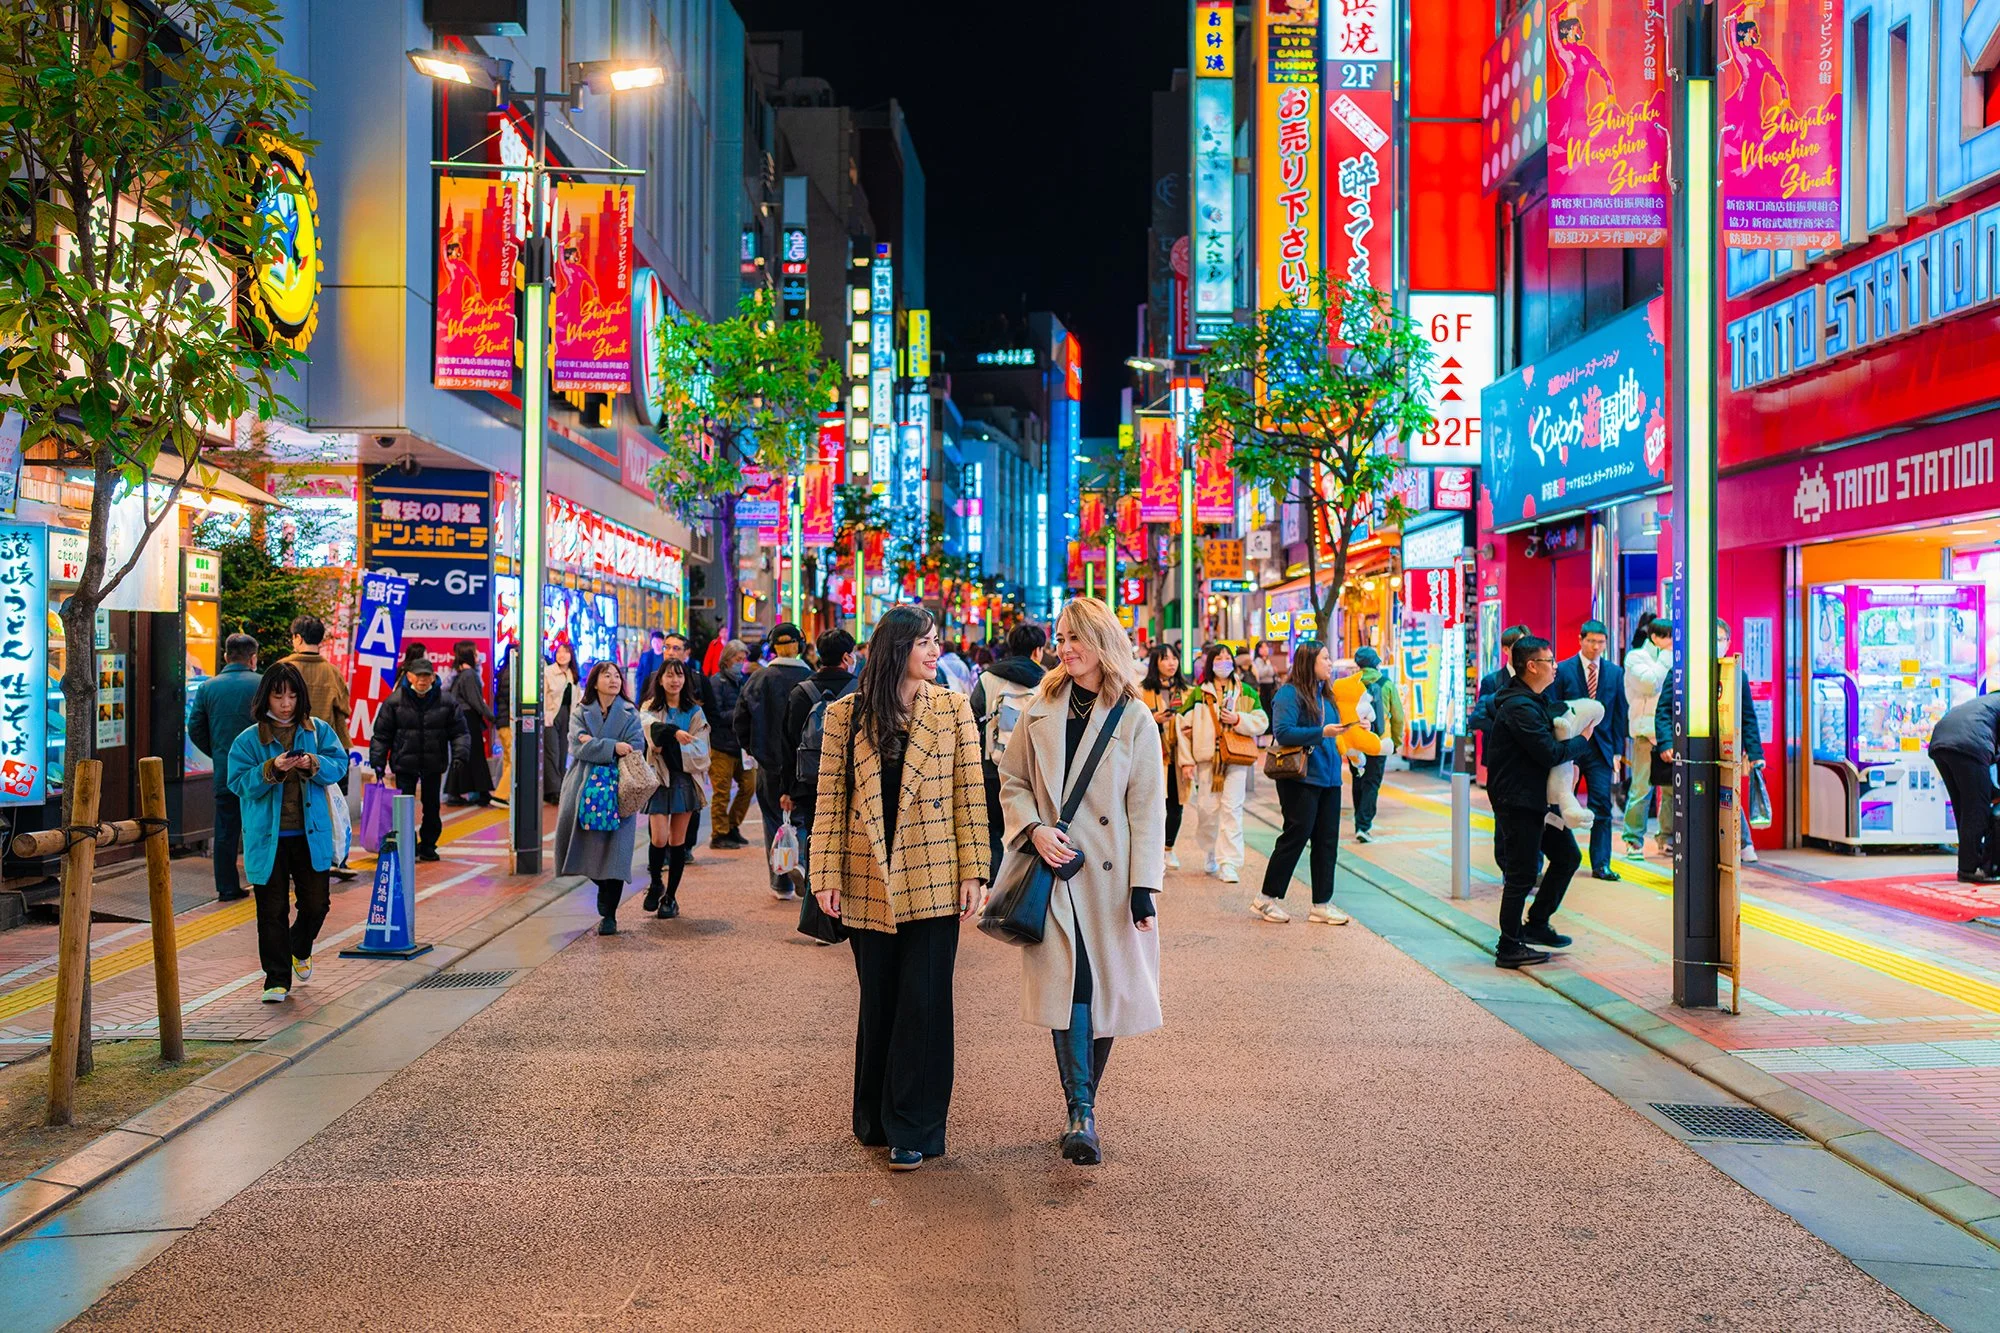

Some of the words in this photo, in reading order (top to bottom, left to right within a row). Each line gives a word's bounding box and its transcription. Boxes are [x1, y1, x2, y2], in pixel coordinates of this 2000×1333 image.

[1277, 49, 1313, 58] GAME
[1281, 37, 1311, 46] DVD
[1275, 61, 1316, 70] HOBBY
[1341, 63, 1378, 88] 2F
[1586, 100, 1660, 137] Shinjuku
[1760, 103, 1837, 141] Shinjuku
[1607, 160, 1662, 196] Street
[1780, 163, 1837, 199] Street
[1555, 214, 1576, 226] 協力
[1729, 216, 1749, 228] 協力
[1554, 231, 1647, 243] 防犯カメラ作動中
[1729, 233, 1819, 246] 防犯カメラ作動中
[462, 296, 511, 320] Shinjuku
[580, 300, 627, 324] Shinjuku
[1430, 313, 1473, 343] 6F
[1728, 288, 1817, 391] TAITO
[474, 334, 509, 358] Street
[592, 339, 628, 361] Street
[1422, 417, 1482, 446] B2F
[1833, 461, 1889, 511] TAITO
[1897, 437, 1994, 501] STATION
[380, 500, 481, 524] 驚安の殿堂
[0, 530, 36, 661] 讃岐うどん
[366, 580, 406, 605] 銀行
[441, 622, 486, 632] VEGAS
[1674, 561, 1683, 737] Musashino
[0, 672, 33, 757] 生そば
